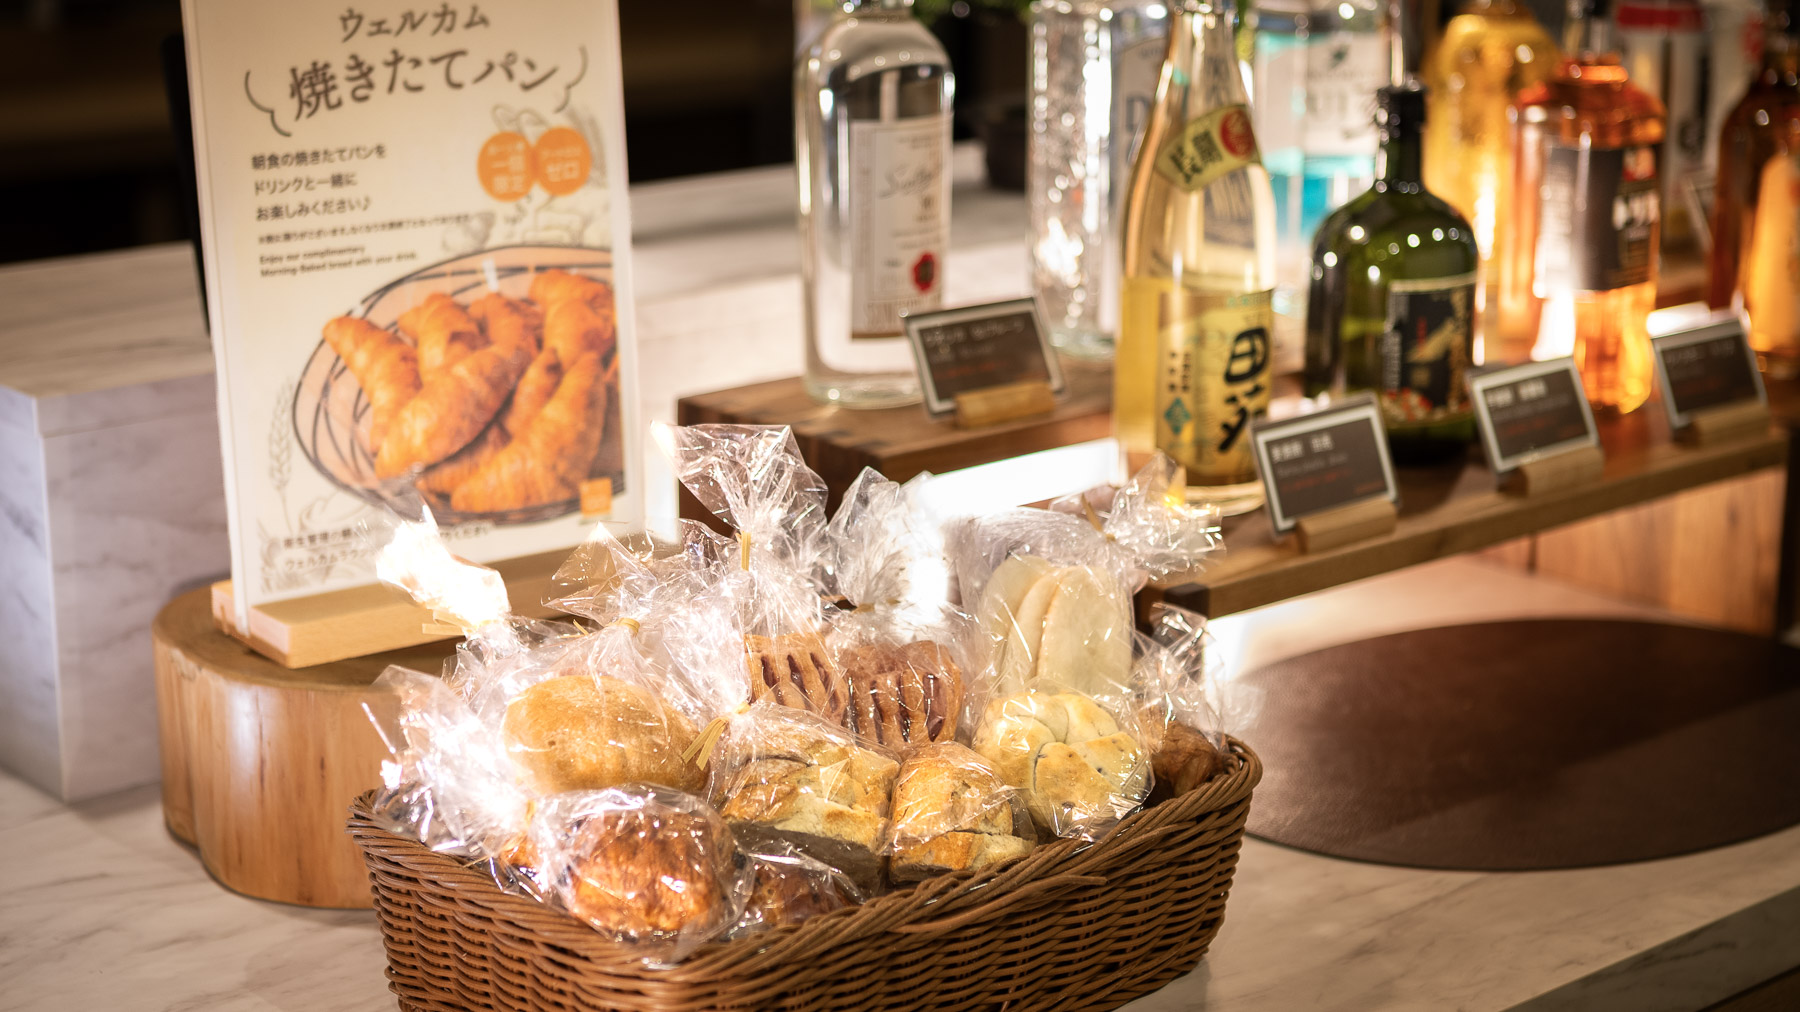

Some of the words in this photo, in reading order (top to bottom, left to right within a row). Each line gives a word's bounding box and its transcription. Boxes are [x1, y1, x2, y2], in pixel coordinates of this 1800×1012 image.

[338, 2, 492, 43] ウェルカム
[289, 48, 560, 122] 焼きたてパン
[251, 143, 387, 170] 朝食の焼きたてパンを
[254, 171, 358, 197] ドリンクと一緒に
[546, 161, 580, 182] ゼロ
[260, 254, 284, 265] Enjoy
